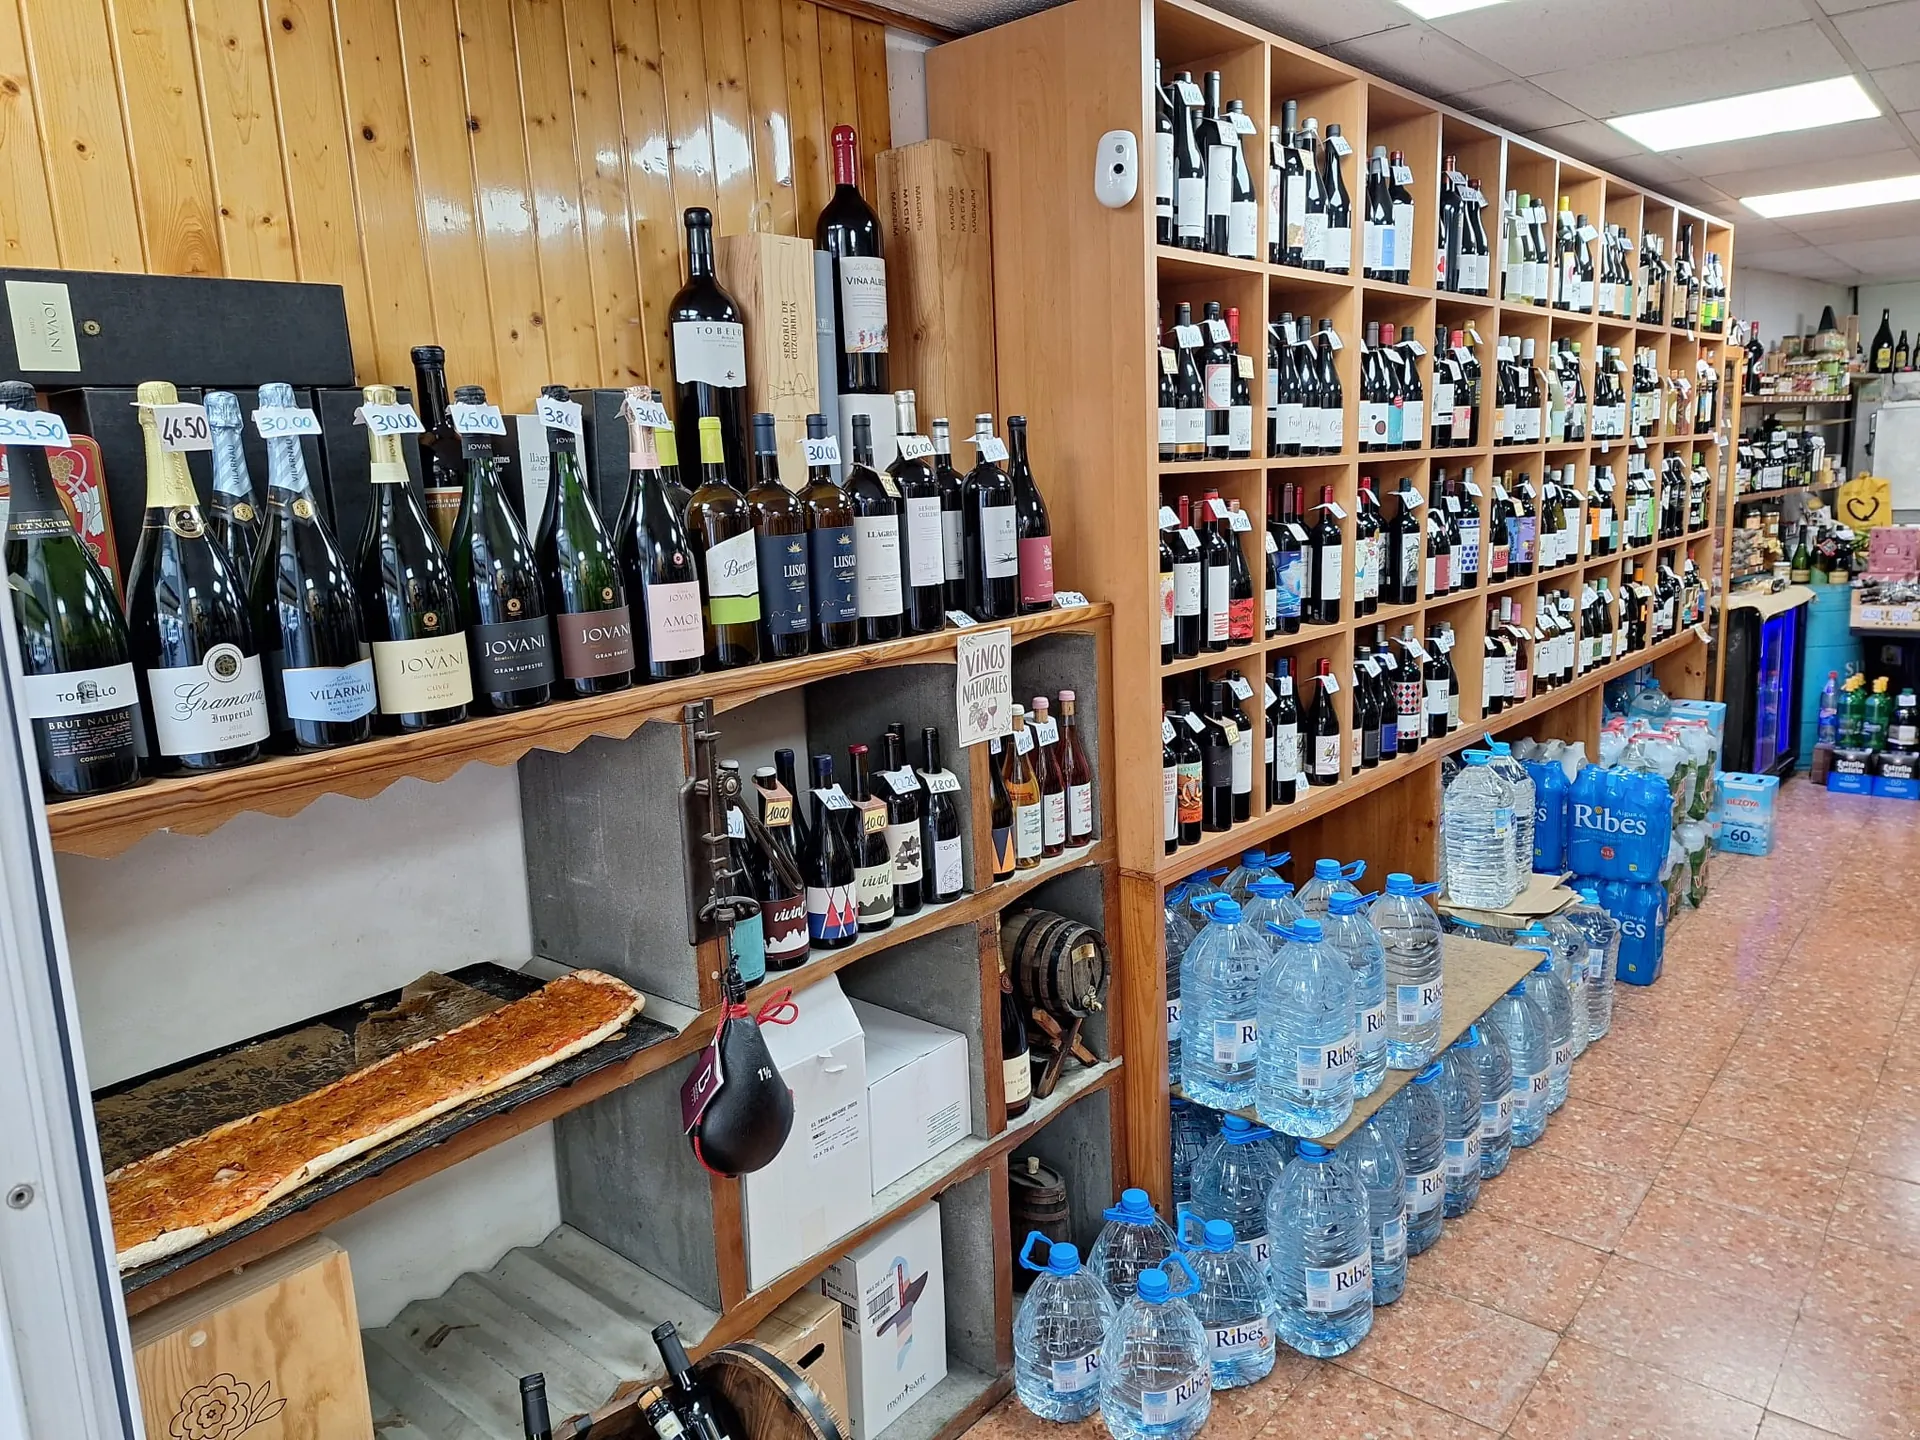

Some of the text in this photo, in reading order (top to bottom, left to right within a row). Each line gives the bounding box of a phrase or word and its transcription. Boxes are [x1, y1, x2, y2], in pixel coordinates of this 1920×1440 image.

[42, 301, 62, 353] JOVANI
[259, 414, 313, 432] 30.00
[372, 412, 418, 432] 30.00
[459, 410, 500, 430] 45.00
[163, 415, 209, 446] 46.50
[808, 445, 838, 461] 30.00
[905, 442, 933, 457] 60.00
[1057, 595, 1086, 606] 26.50
[663, 615, 700, 627] AMOR
[484, 635, 546, 657] JOVANI
[401, 651, 464, 675] JOVANI
[494, 667, 514, 675] GRAN
[310, 682, 371, 702] VILARNAU
[962, 674, 1008, 706] NATURALES
[170, 681, 265, 721] Gramona
[48, 711, 131, 731] BRUT NATURE
[211, 706, 253, 725] Imperial
[1573, 803, 1647, 836] Ribes
[1616, 809, 1638, 818] Aigua
[1617, 910, 1638, 922] Aigua
[1215, 1323, 1265, 1348] Ribes
